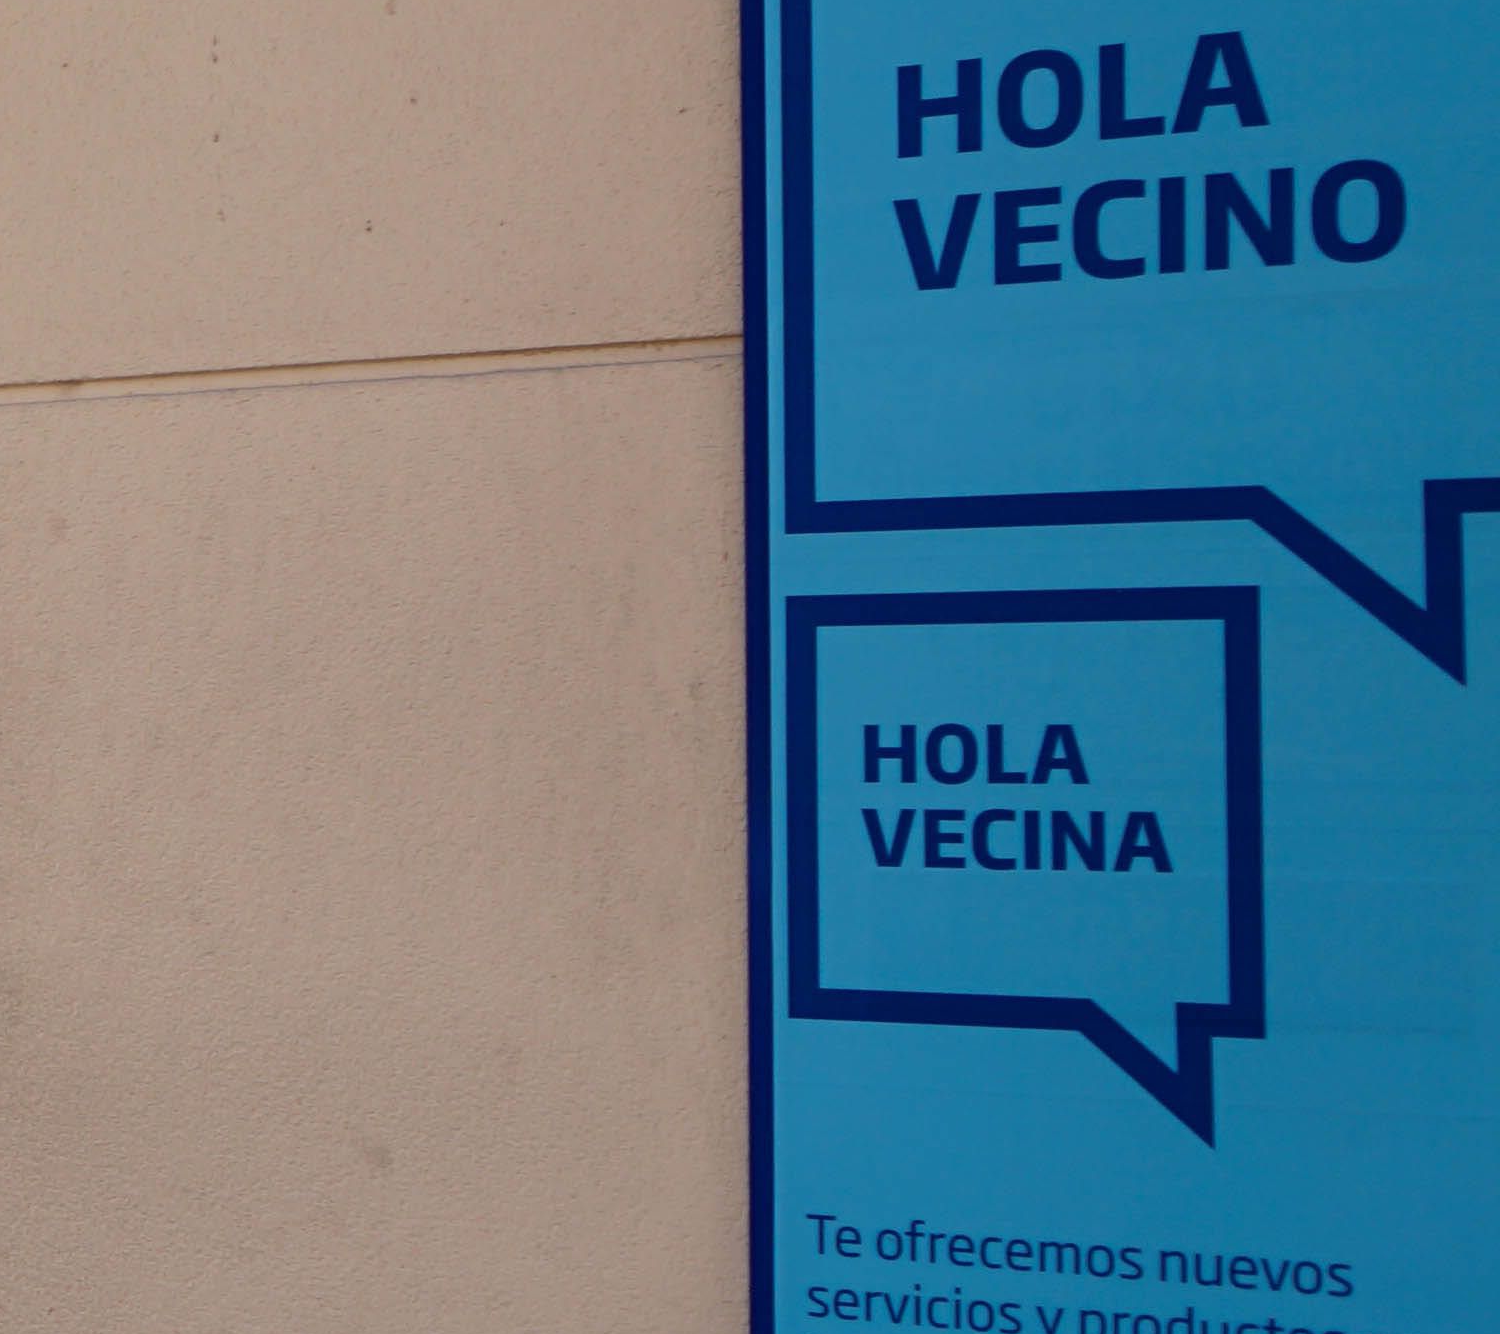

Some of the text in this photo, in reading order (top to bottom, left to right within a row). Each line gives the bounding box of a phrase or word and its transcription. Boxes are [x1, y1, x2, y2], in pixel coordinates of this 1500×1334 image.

[896, 30, 1271, 159] HOLA
[891, 158, 1408, 291] VECINO
[862, 722, 1090, 785] HOLA
[861, 808, 1174, 873] VECINA
[806, 1213, 1353, 1298] Te ofrecemos nuevos
